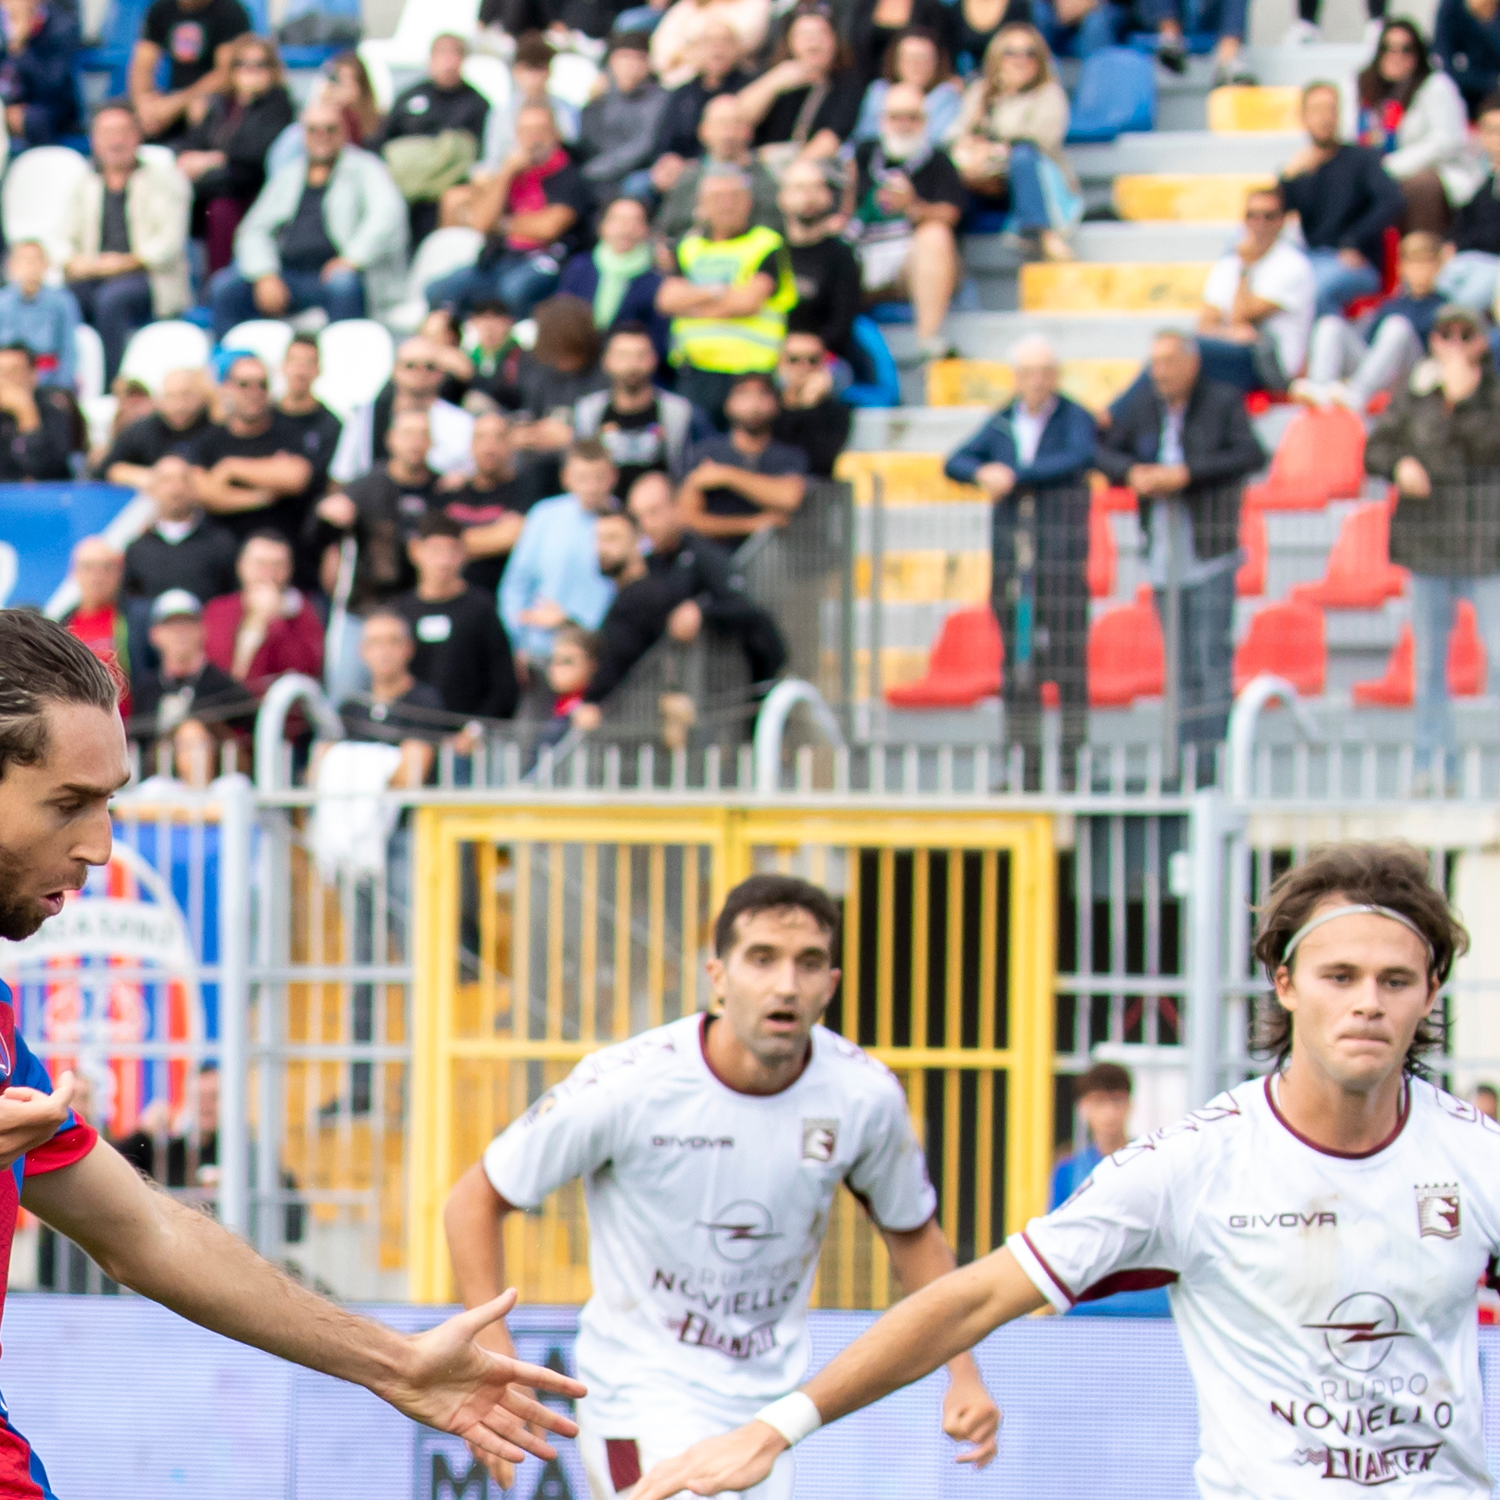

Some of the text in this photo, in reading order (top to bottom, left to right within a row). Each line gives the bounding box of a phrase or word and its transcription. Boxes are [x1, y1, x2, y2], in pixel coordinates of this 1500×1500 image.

[1229, 1211, 1338, 1228] GIVOVA
[1321, 1373, 1429, 1403] RUPPO
[1269, 1400, 1454, 1436] NOVIELLO
